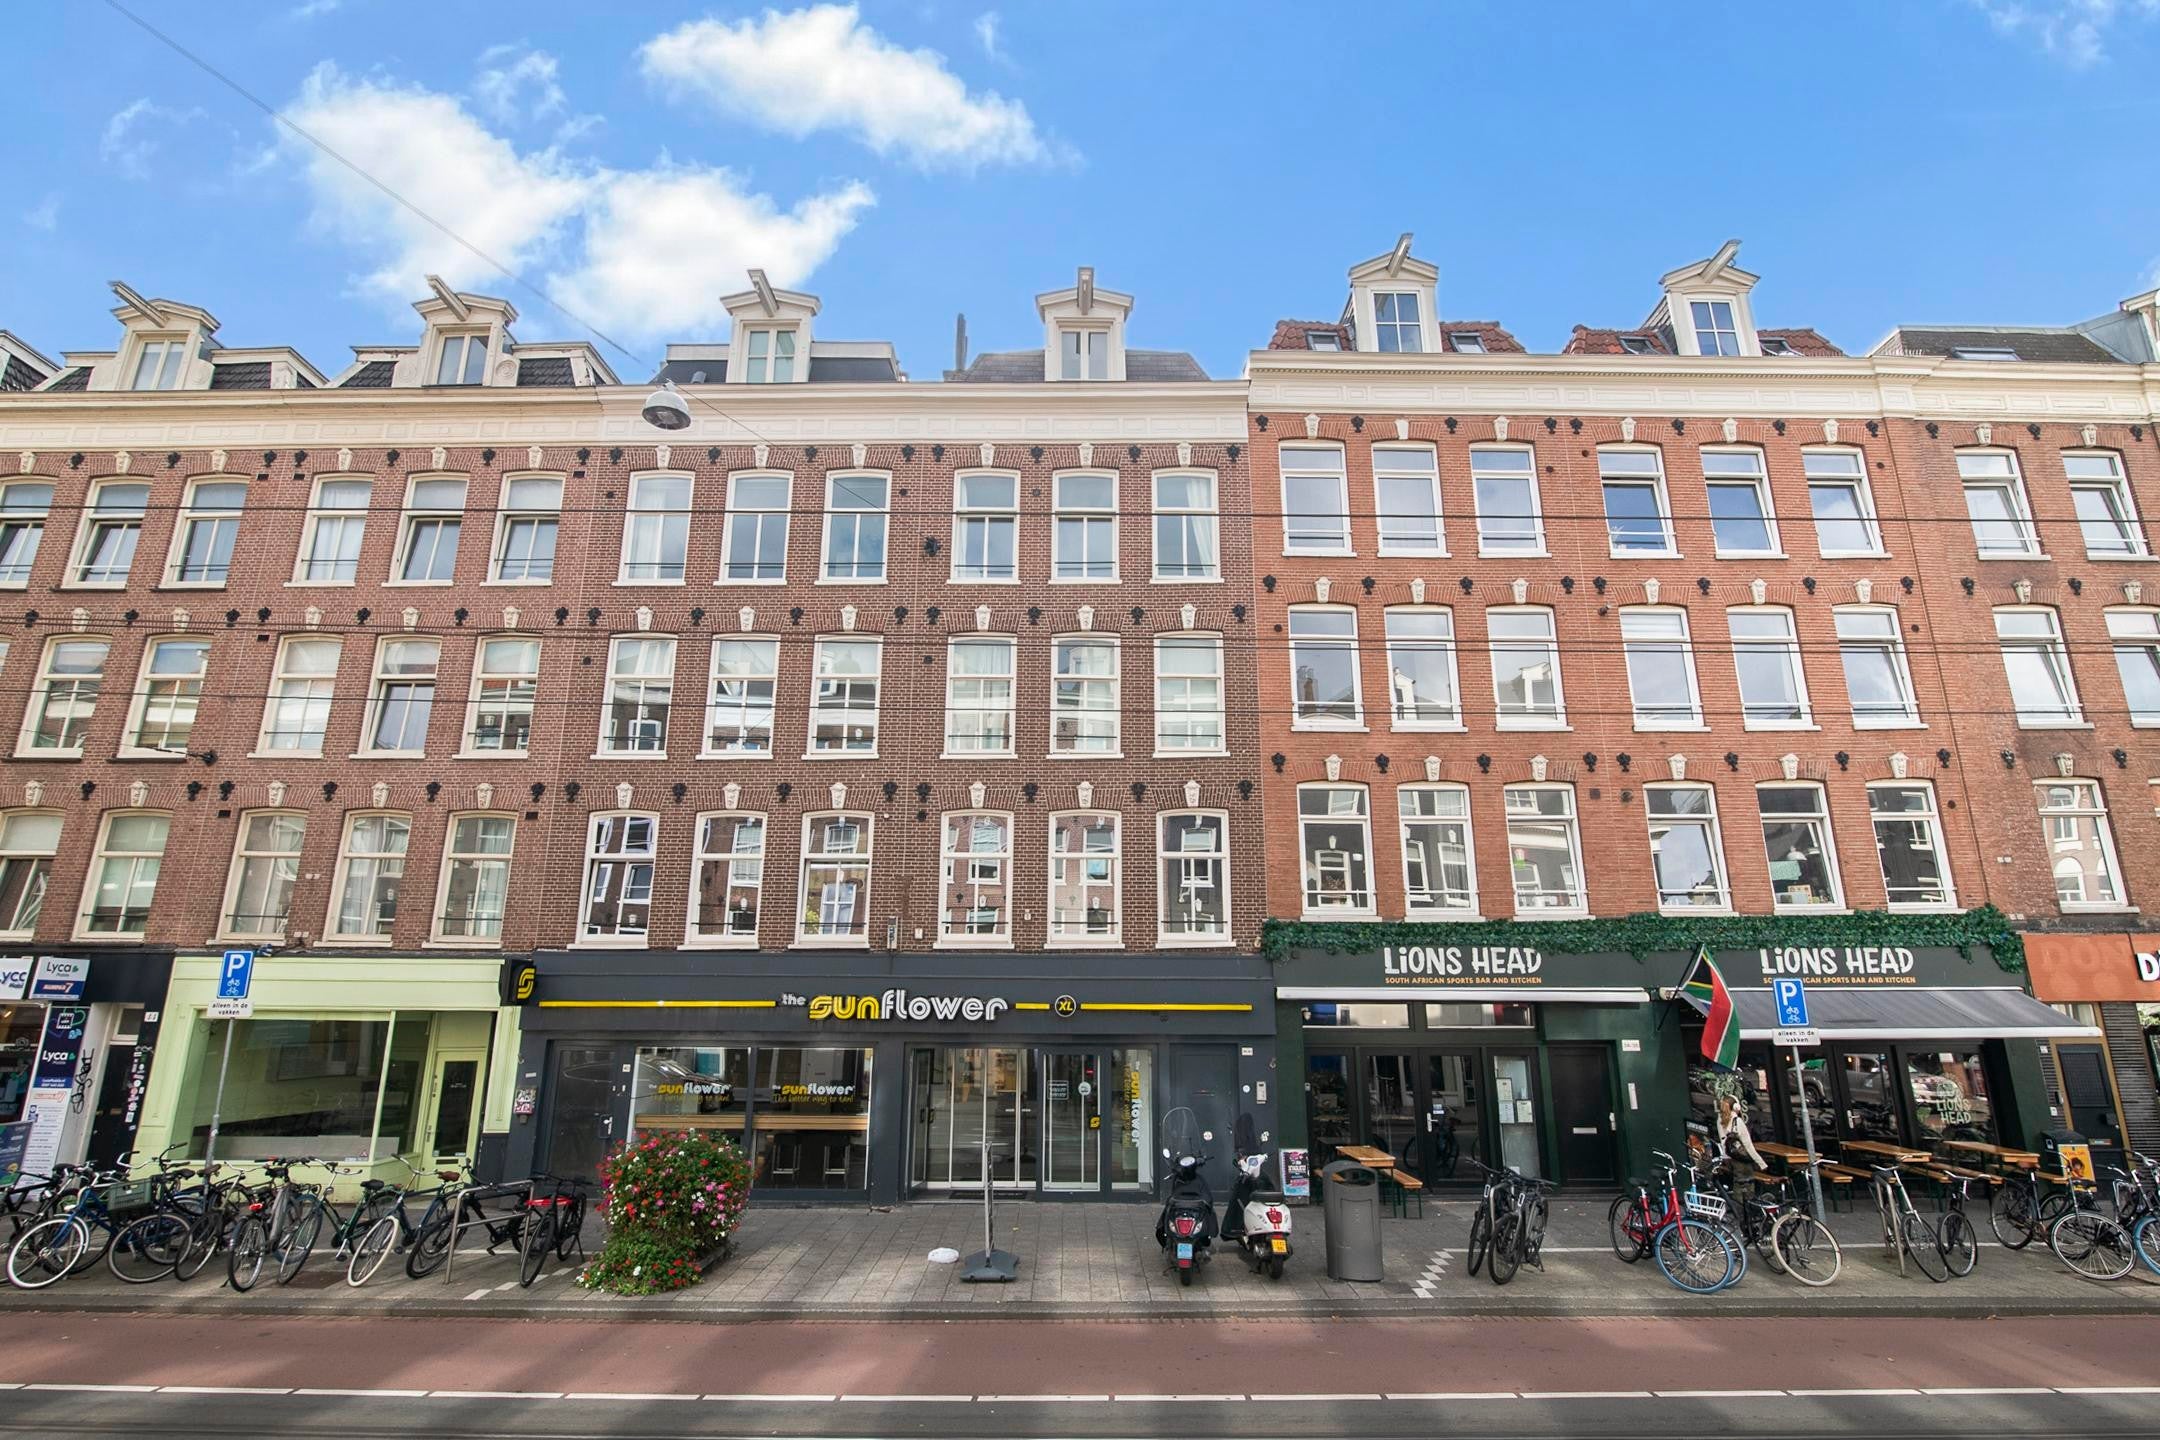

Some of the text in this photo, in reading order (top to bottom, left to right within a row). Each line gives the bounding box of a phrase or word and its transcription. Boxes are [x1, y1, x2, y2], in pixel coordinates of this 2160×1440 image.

[46, 961, 72, 973] Lyca
[227, 954, 246, 978] P
[1471, 947, 1542, 974] HEAD
[1845, 947, 1914, 974] HEAD
[1780, 982, 1797, 1006] P
[782, 989, 1009, 1021] the sunflower
[1057, 1000, 1074, 1011] XL
[42, 1050, 68, 1062] Lyca
[658, 1082, 731, 1095] sunflower
[781, 1083, 854, 1095] sunflower
[1940, 1111, 1972, 1124] HEAD
